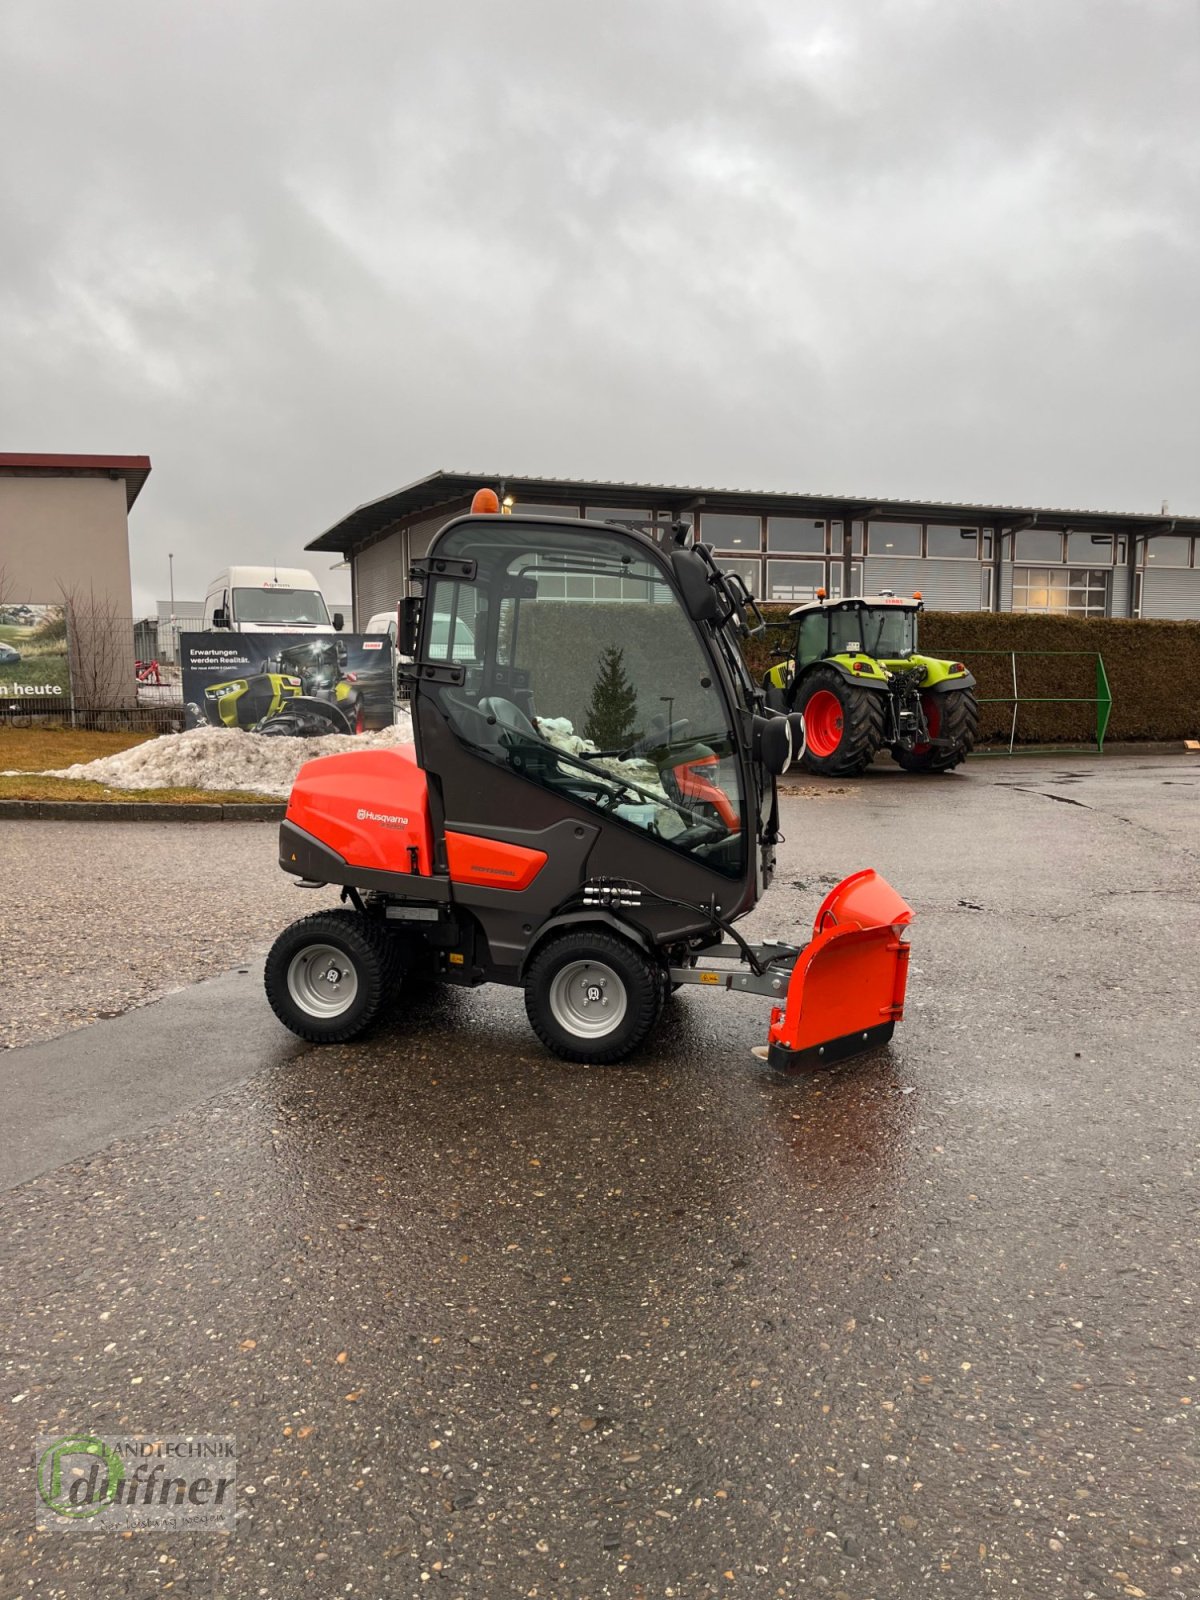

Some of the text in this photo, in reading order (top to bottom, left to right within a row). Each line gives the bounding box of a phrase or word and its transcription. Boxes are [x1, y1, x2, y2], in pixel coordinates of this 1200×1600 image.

[190, 649, 238, 657] Erwartungen
[13, 682, 62, 695] heute
[365, 811, 409, 825] Husqvarna
